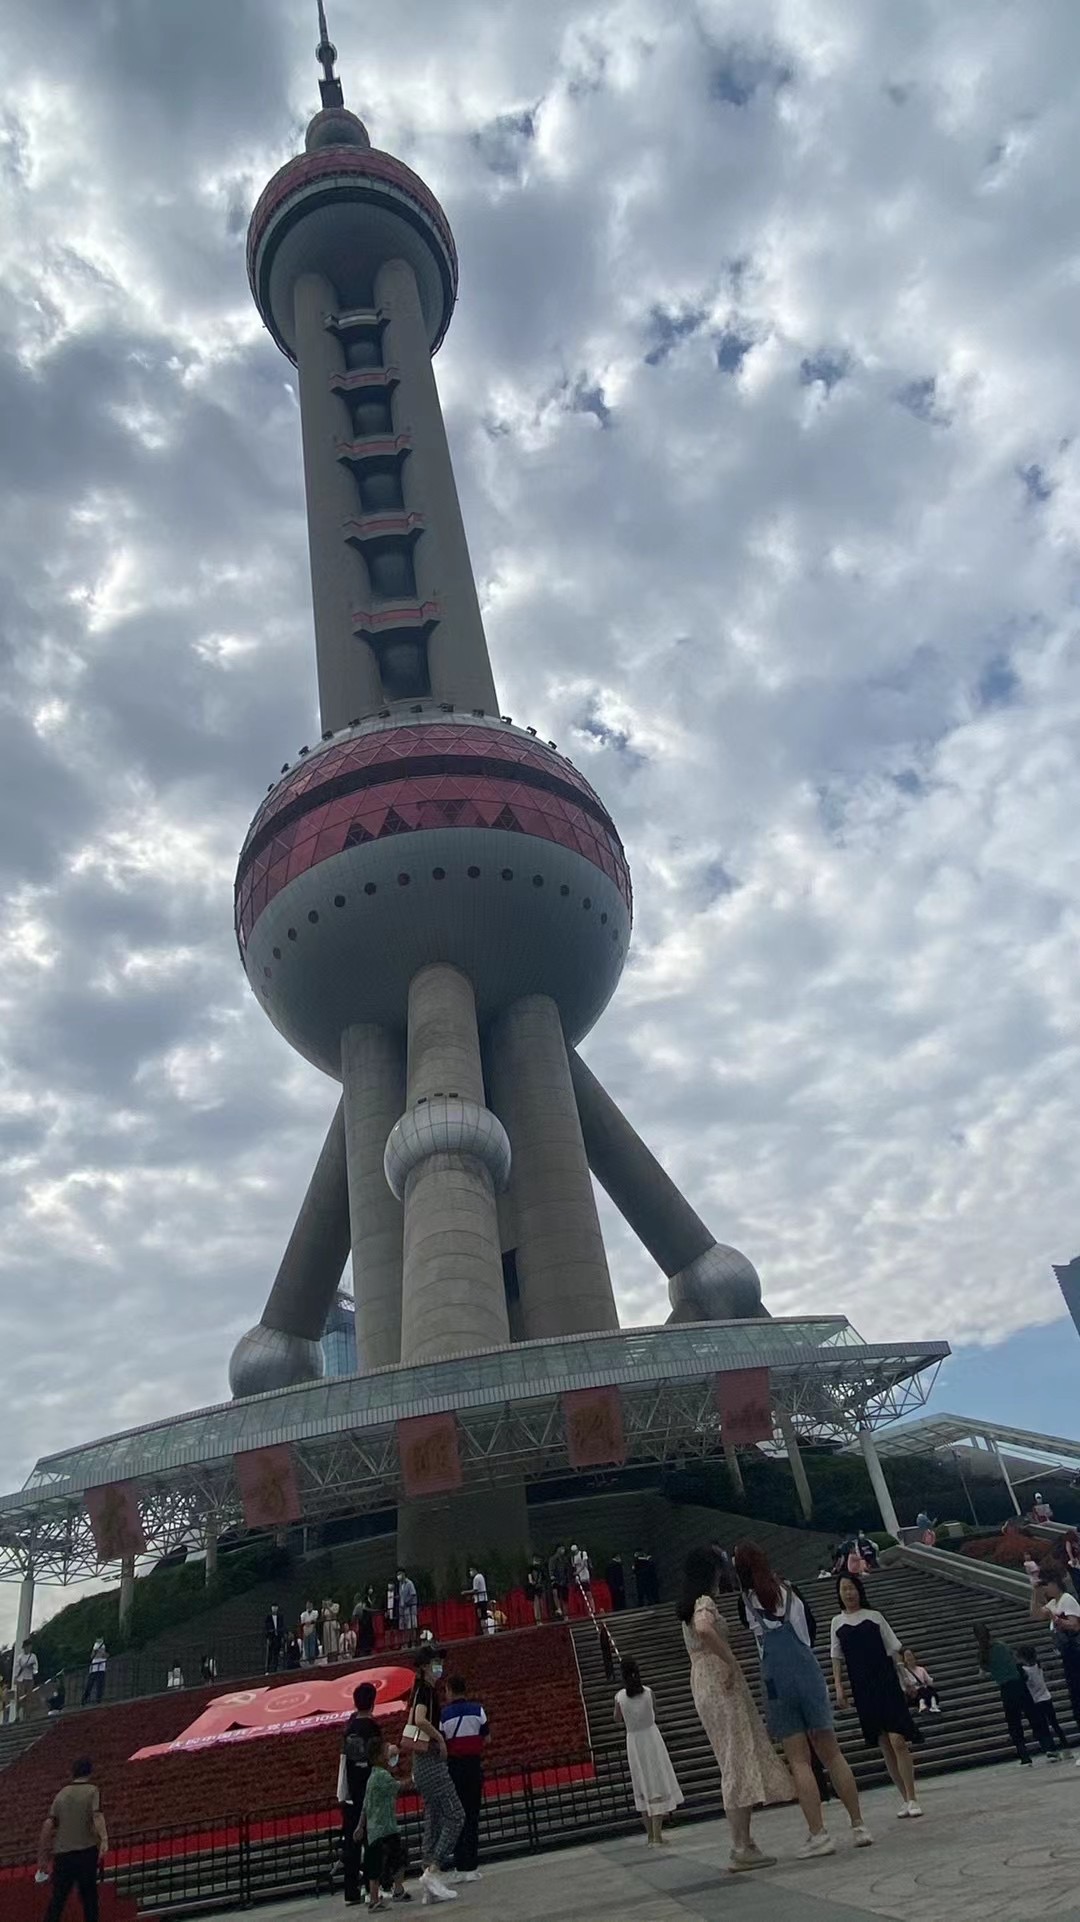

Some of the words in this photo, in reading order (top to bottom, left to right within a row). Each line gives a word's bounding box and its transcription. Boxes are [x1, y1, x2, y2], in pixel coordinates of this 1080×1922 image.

[169, 1710, 355, 1749] 庆祝中国共产党成立100周
